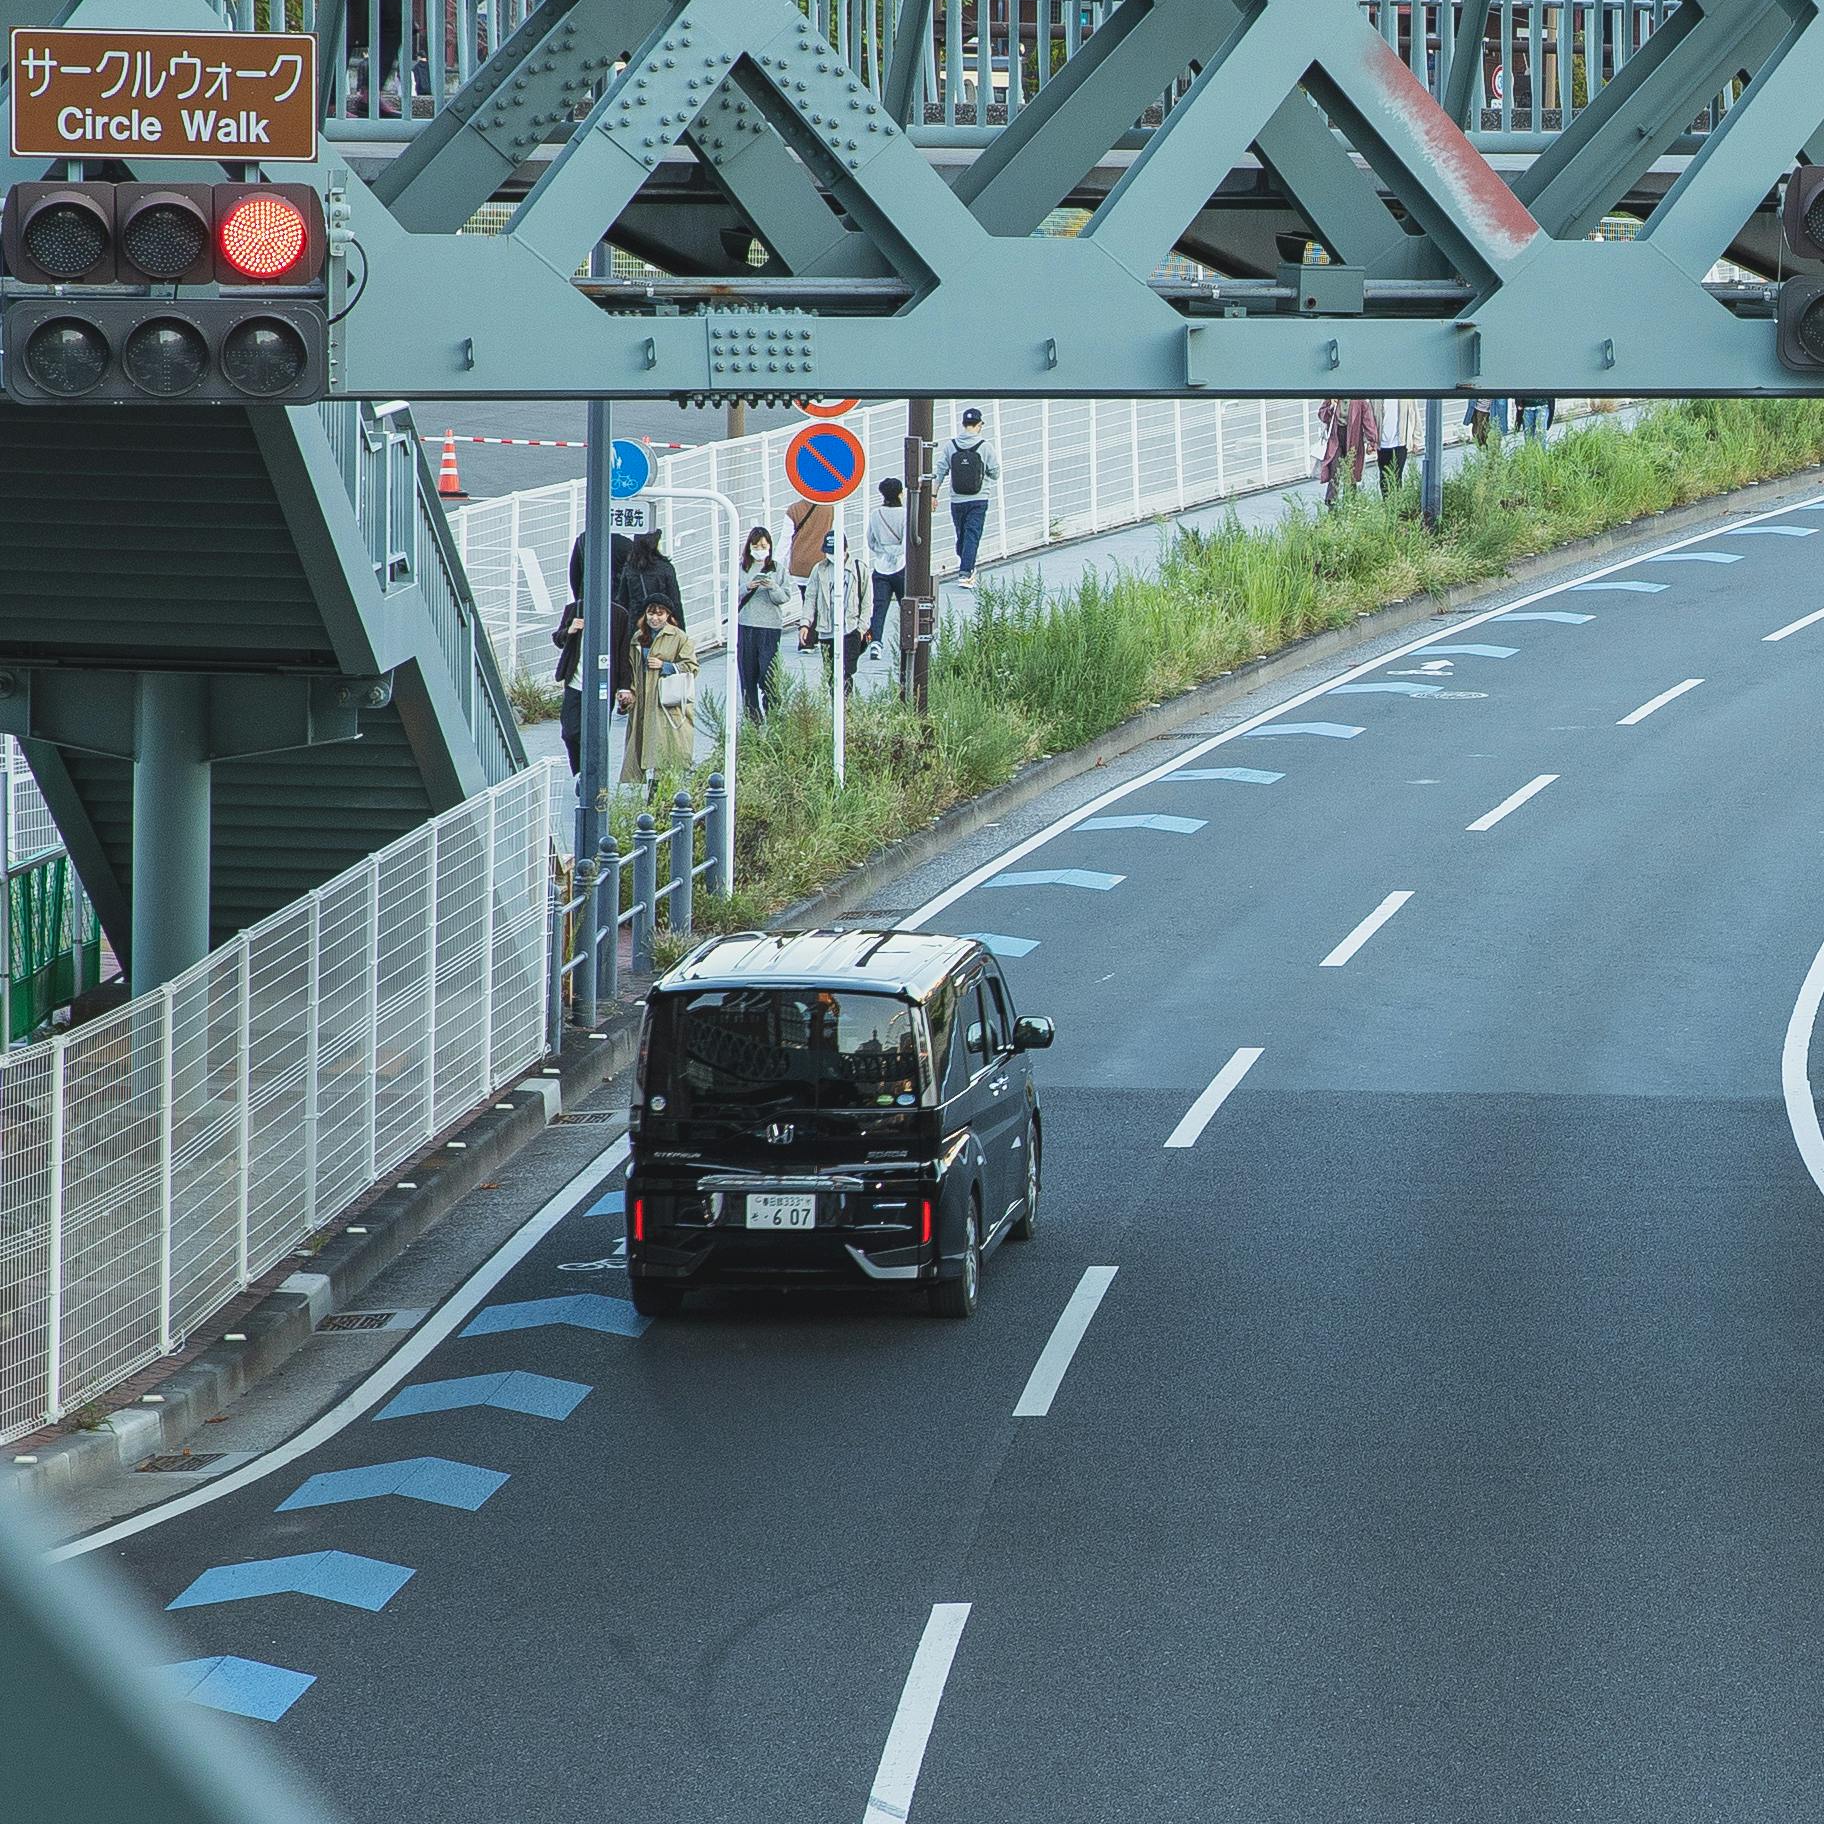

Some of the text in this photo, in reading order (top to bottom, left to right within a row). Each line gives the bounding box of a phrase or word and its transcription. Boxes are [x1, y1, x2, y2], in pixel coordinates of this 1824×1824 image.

[20, 47, 303, 102] サークルウォーク
[57, 106, 271, 144] Circle Walk
